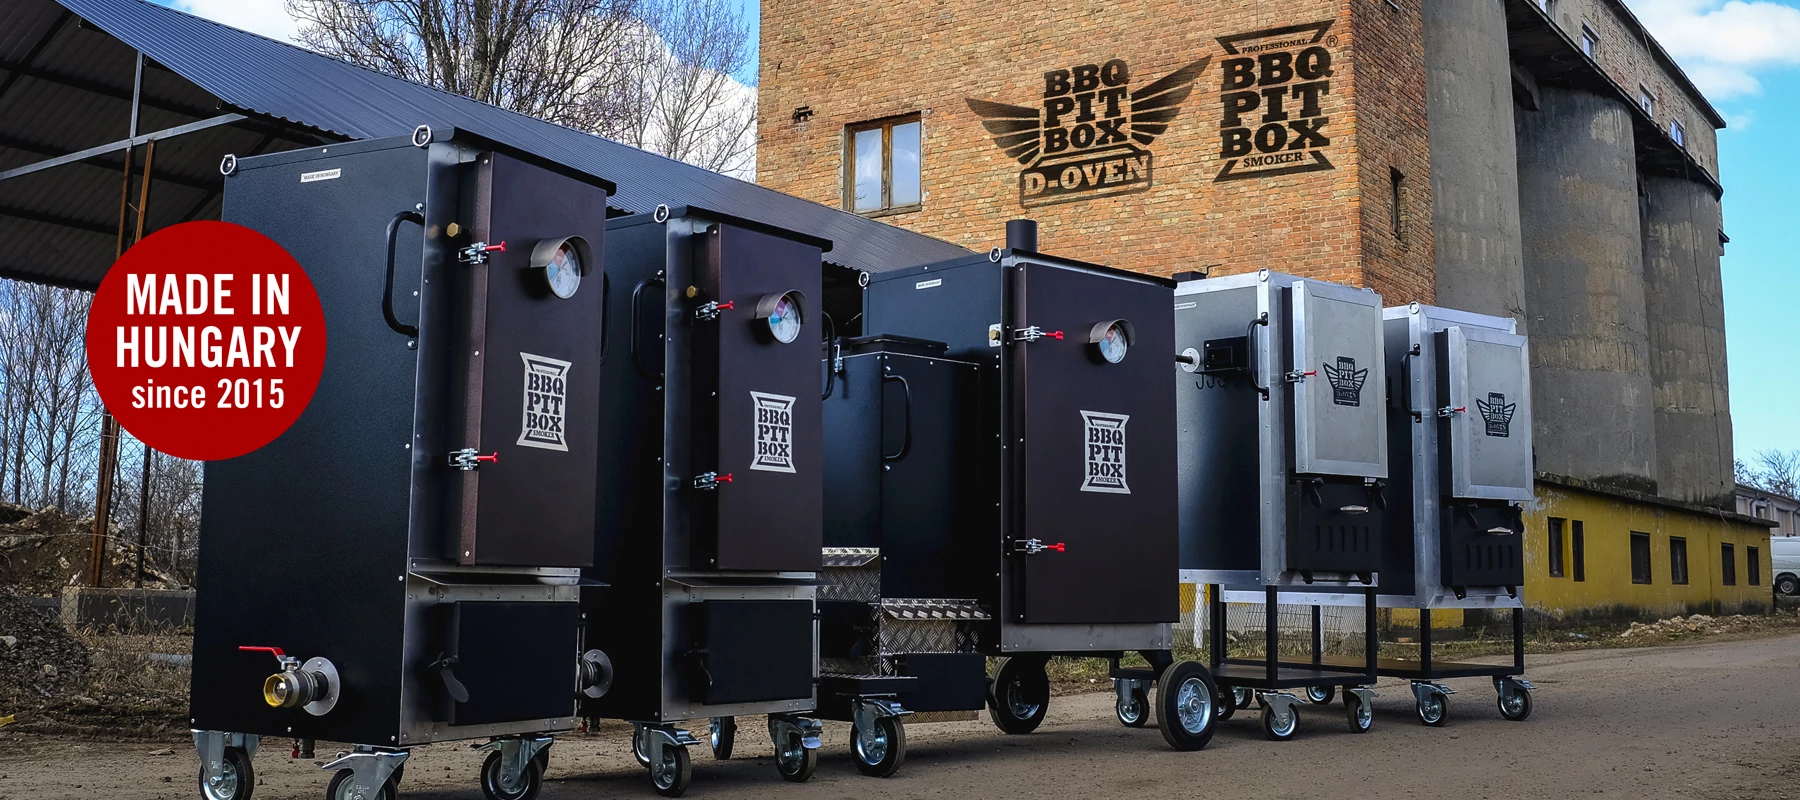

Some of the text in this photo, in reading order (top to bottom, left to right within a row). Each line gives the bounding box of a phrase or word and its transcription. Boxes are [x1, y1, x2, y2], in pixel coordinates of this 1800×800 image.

[1241, 38, 1308, 54] PROFESSIONAL
[1043, 58, 1131, 98] BBQ
[1220, 46, 1335, 92] BBQ
[1043, 86, 1127, 129] PIT
[1220, 80, 1330, 128] PIT
[1043, 117, 1128, 154] BOX
[1220, 117, 1331, 159] BOX
[1243, 151, 1304, 168] SMOKER
[1022, 154, 1149, 196] D-OVEN
[1338, 361, 1354, 371] BBQ
[1339, 370, 1354, 380] PIT
[528, 372, 564, 396] BBQ
[1339, 379, 1354, 388] BOX
[527, 391, 562, 415] PIT
[1490, 405, 1503, 414] PIT
[526, 412, 562, 433] BOX
[758, 408, 790, 426] BBQ
[533, 430, 555, 438] SMOKER
[758, 424, 789, 443] PIT
[1089, 427, 1124, 446] BBQ
[758, 441, 789, 457] BOX
[1089, 444, 1123, 463] PIT
[1089, 462, 1123, 478] BOX
